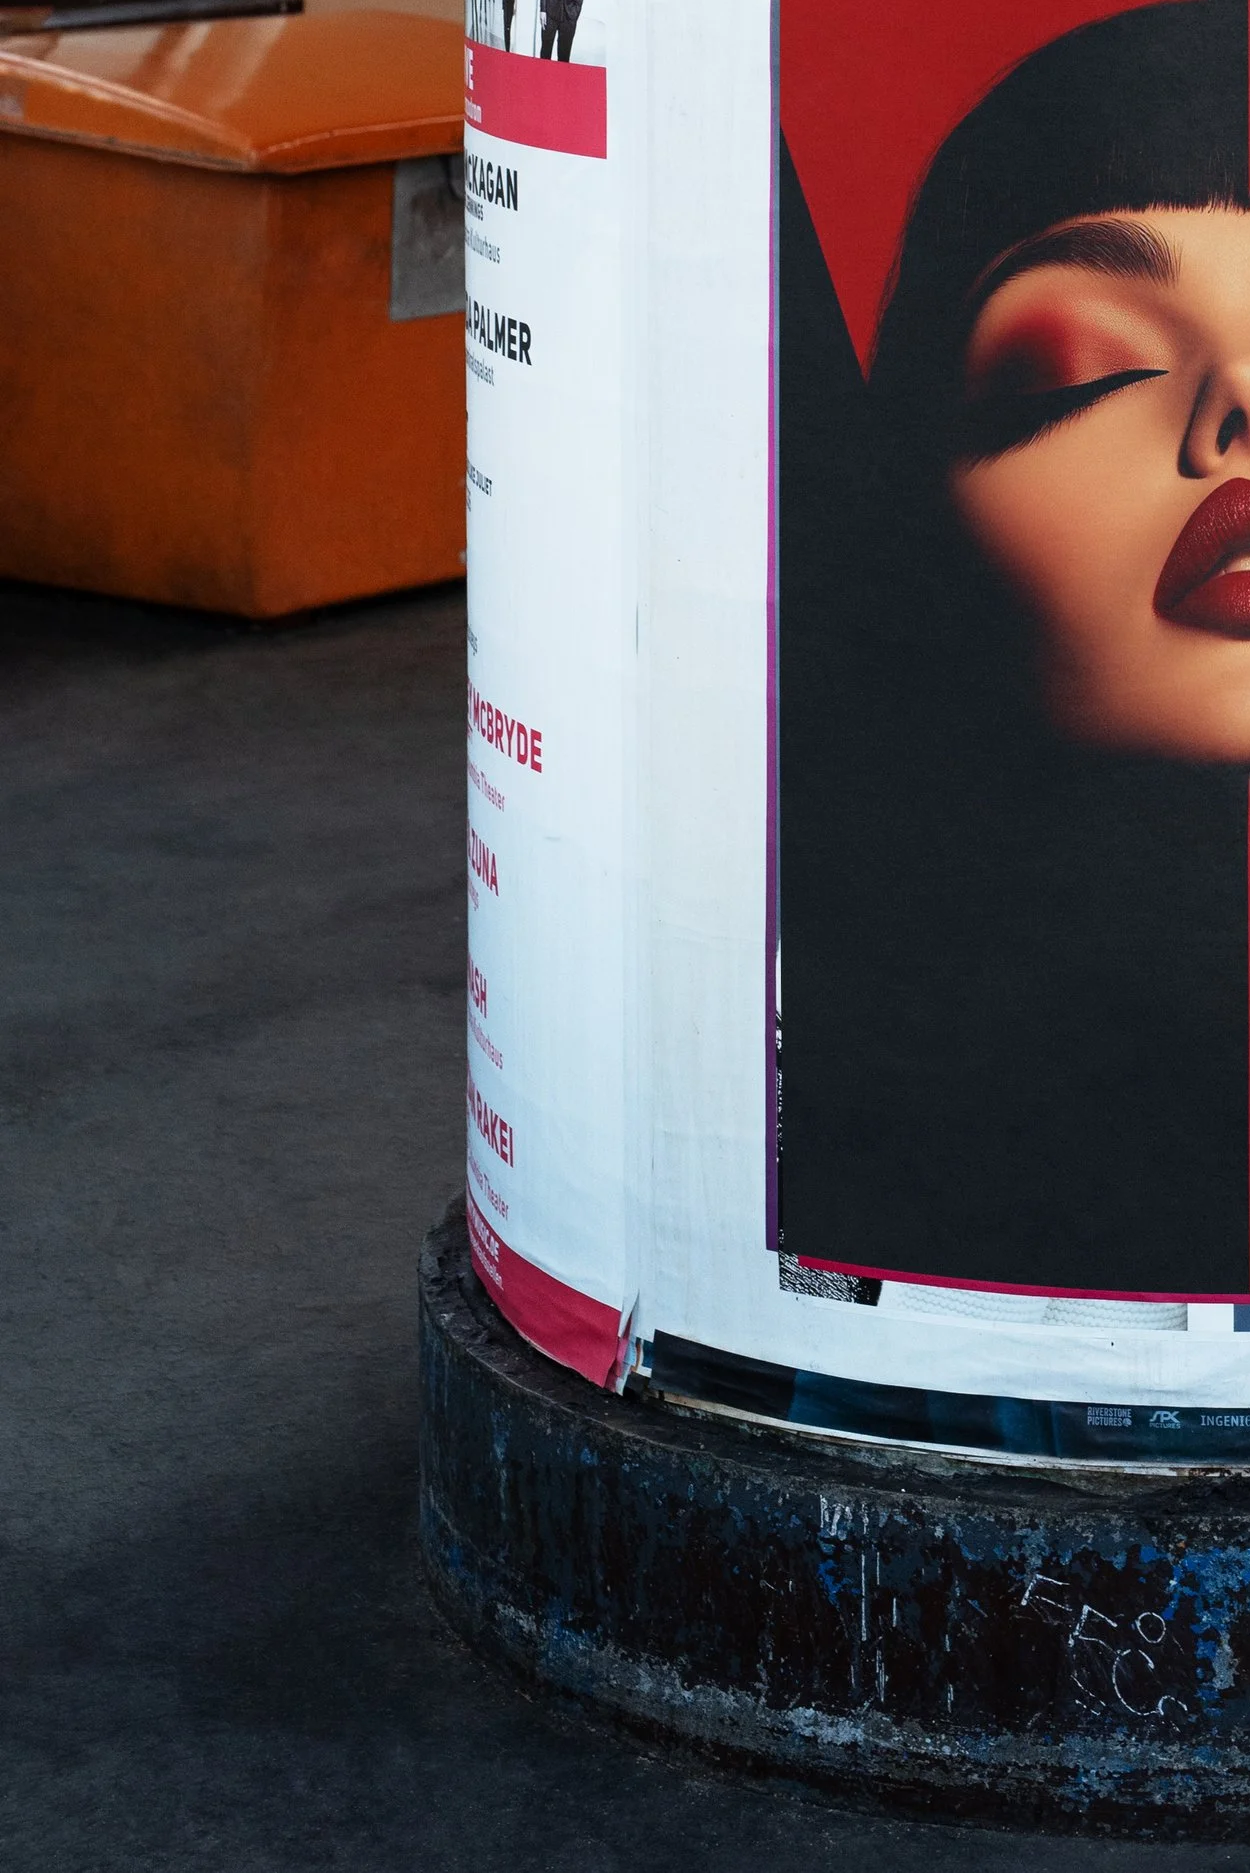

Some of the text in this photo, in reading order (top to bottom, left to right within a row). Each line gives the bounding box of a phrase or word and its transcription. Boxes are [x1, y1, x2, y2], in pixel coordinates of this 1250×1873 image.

[473, 299, 532, 366] PALMER
[473, 687, 543, 774] McBRYDE
[1087, 1406, 1132, 1418] RIVERSTONE
[1087, 1416, 1123, 1427] PICTURES
